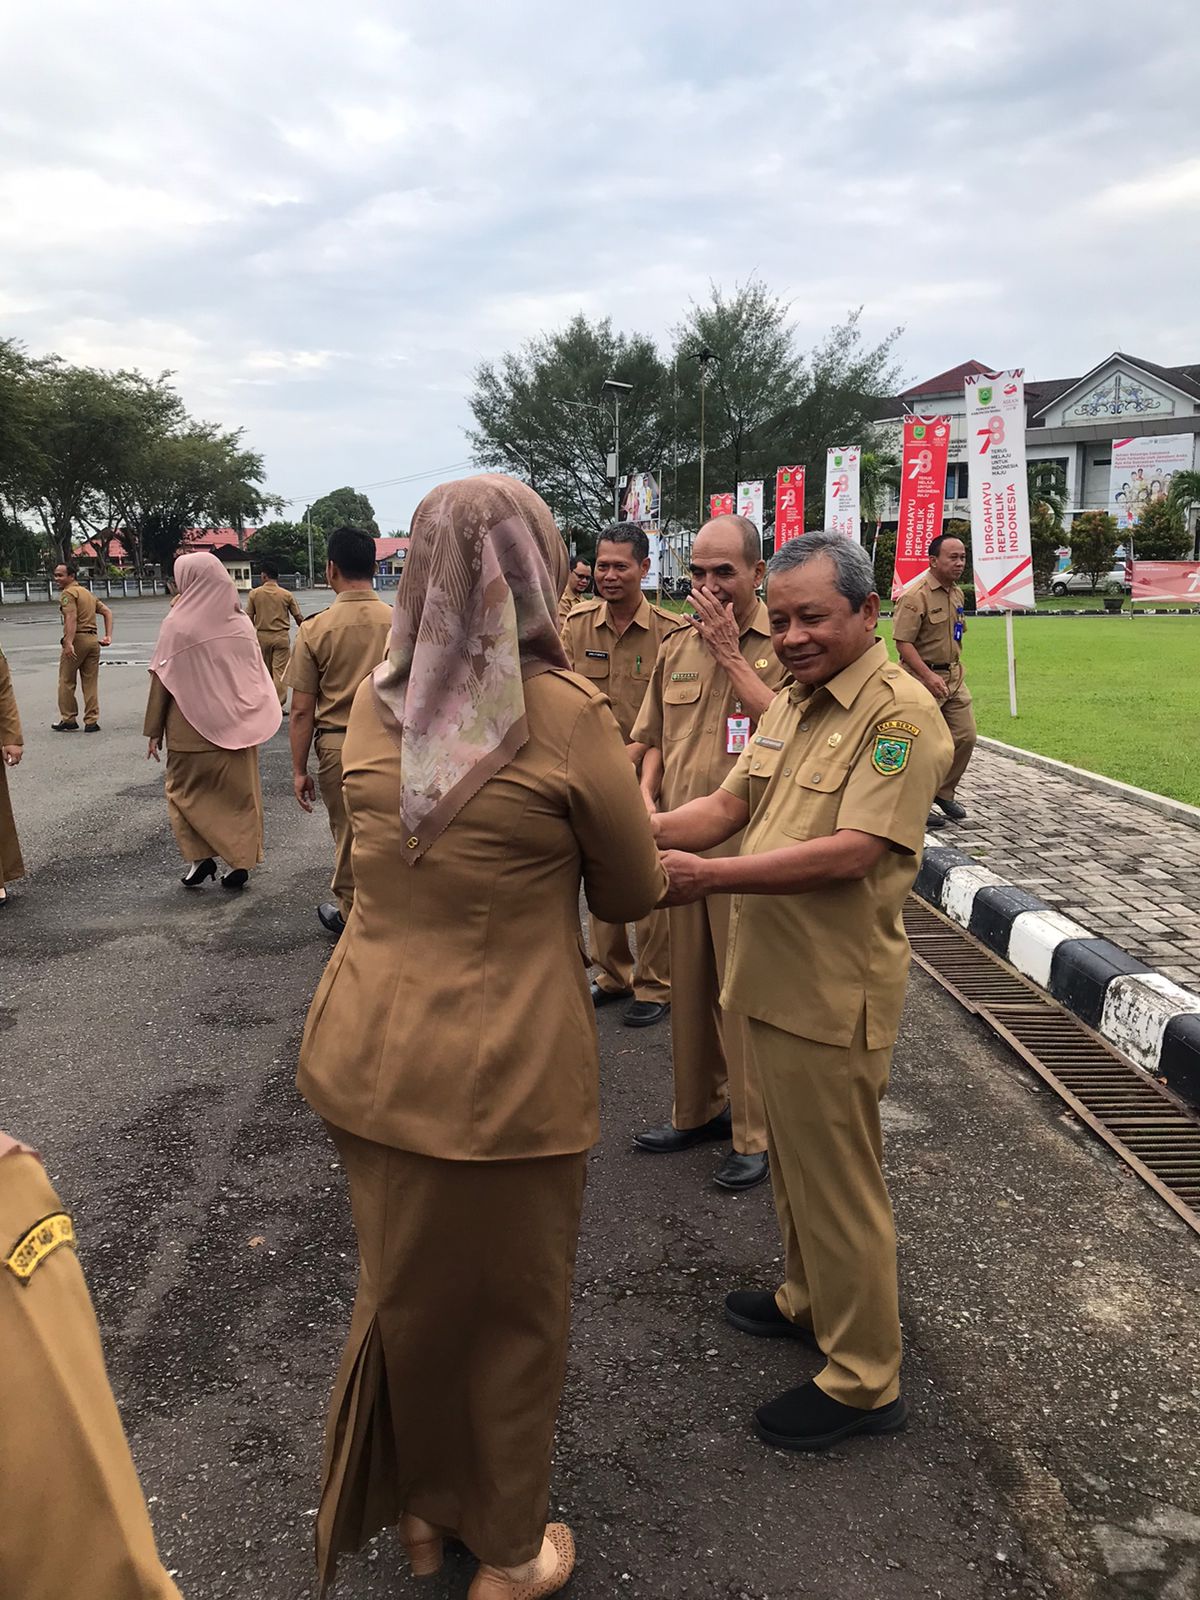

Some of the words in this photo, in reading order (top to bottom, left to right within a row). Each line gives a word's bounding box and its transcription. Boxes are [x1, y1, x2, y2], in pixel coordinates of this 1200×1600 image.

[976, 415, 1005, 455] 78
[832, 474, 849, 498] 78
[908, 449, 933, 480] 78
[904, 498, 916, 556] DIRGAHAYU
[914, 508, 925, 556] REPUBLIK
[982, 482, 995, 554] DIRGAHAYU
[995, 492, 1006, 553] REPUBLIK
[1007, 483, 1019, 552] INDONESIA
